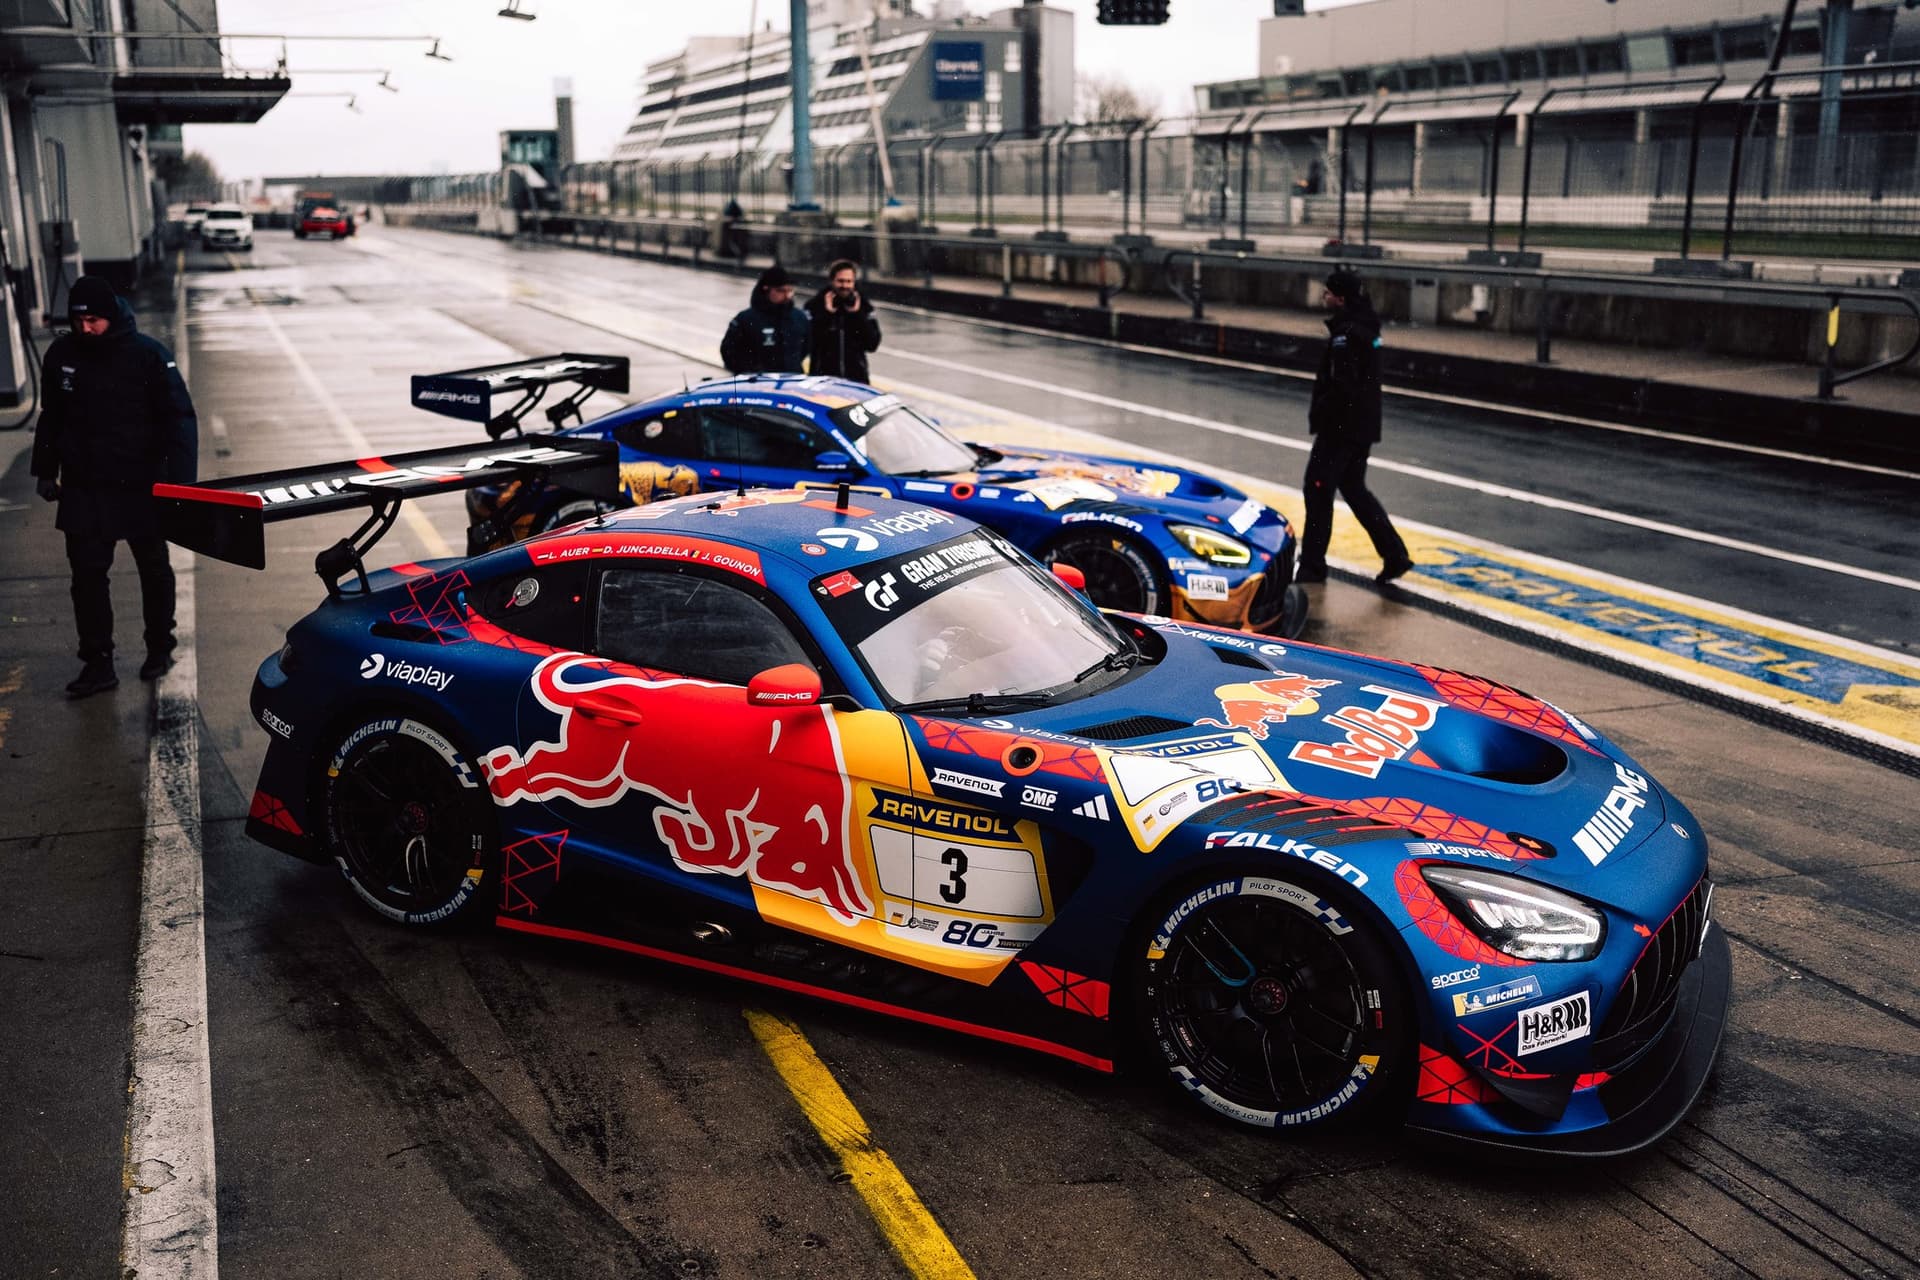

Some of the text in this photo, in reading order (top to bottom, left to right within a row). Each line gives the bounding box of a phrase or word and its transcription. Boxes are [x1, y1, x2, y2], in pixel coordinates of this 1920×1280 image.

[440, 392, 481, 405] AMG
[861, 508, 954, 538] viaplay
[560, 547, 590, 559] AUER
[603, 545, 690, 557] D. JUNCADELLA
[700, 552, 761, 577] J. GOUNON
[900, 552, 949, 584] GRAN
[918, 579, 937, 591] THE
[934, 572, 954, 584] REAL
[386, 660, 455, 692] viaplay
[774, 692, 812, 700] AMG
[341, 719, 397, 756] MICHELIN
[406, 723, 449, 751] PILOT SPORT
[1115, 740, 1232, 758] VENOL
[938, 772, 998, 794] RAVENOL
[1021, 788, 1057, 808] OMP
[882, 798, 1009, 835] RAVENOL
[1203, 830, 1369, 888] FALKEN
[939, 847, 968, 904] 3
[409, 889, 467, 923] MICHELIN
[1249, 882, 1308, 903] PILOT SPORT
[1164, 881, 1236, 935] MICHELIN
[942, 919, 998, 949] 80
[1431, 967, 1479, 988] sparco
[1486, 983, 1534, 1004] MICHELIN
[1522, 1005, 1566, 1043] H&R
[1282, 1079, 1360, 1126] MICHELIN
